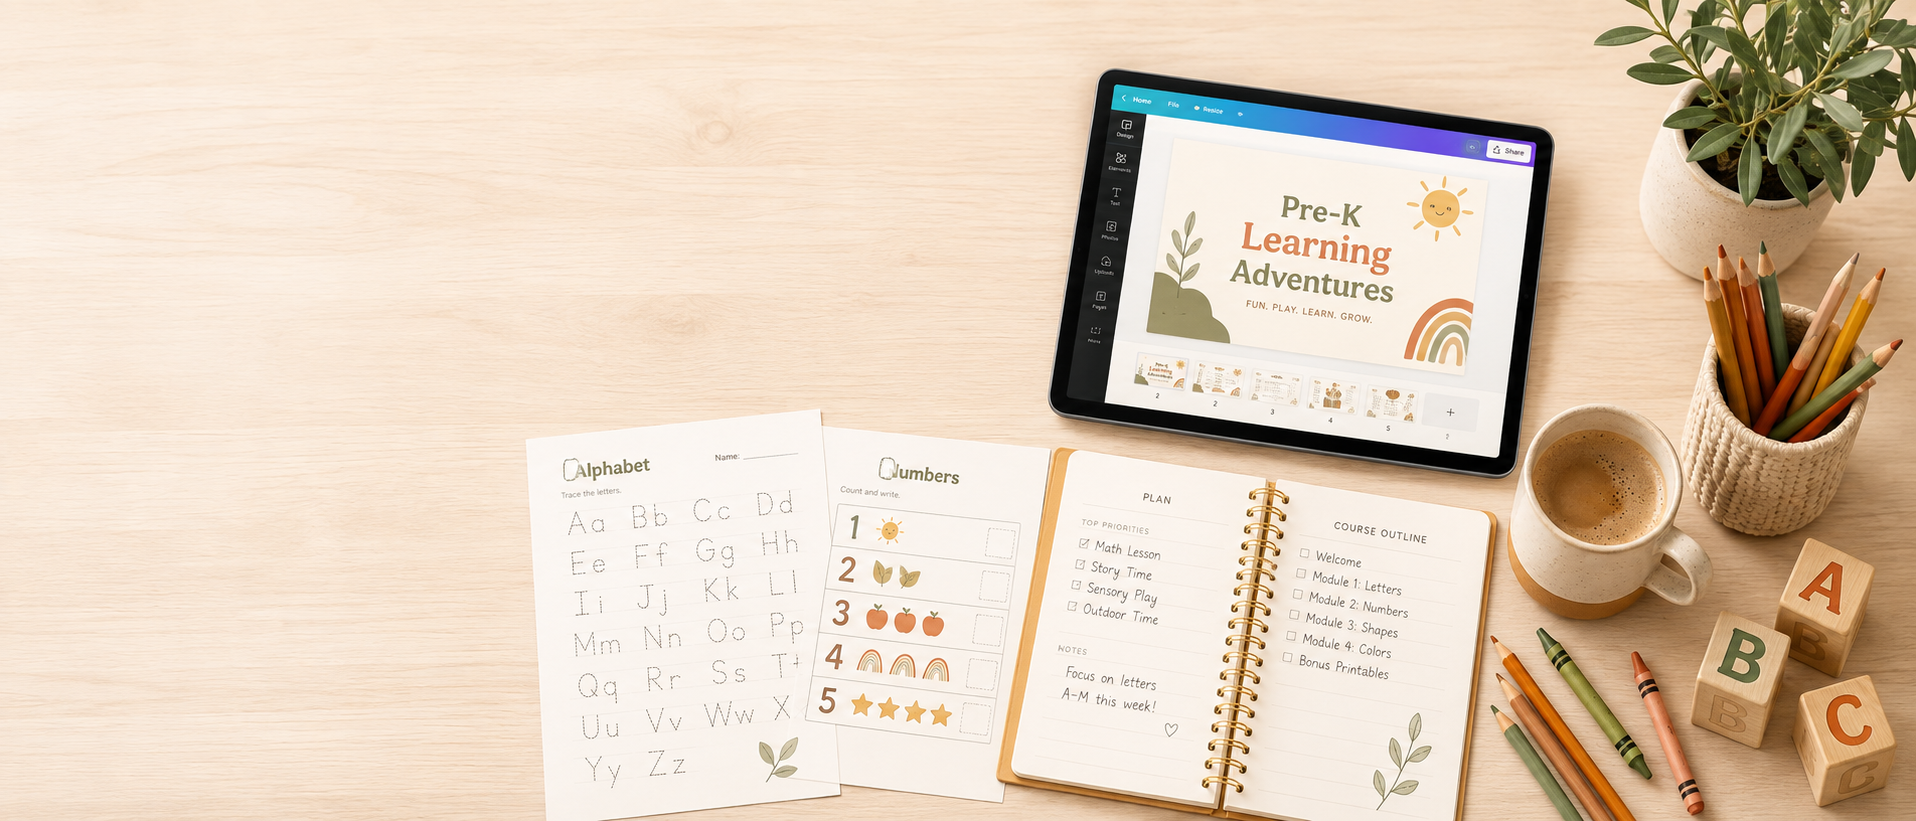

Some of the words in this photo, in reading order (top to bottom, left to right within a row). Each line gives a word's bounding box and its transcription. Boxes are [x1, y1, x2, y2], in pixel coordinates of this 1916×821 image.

[1132, 96, 1152, 105] Home
[1504, 148, 1524, 156] Share
[1281, 195, 1363, 228] Pre-K
[1241, 221, 1393, 276] Learning
[1229, 259, 1394, 303] Adventures
[1246, 299, 1268, 310] FUN.
[1272, 303, 1298, 314] PLAY.
[1302, 307, 1337, 320] LEARN.
[1340, 312, 1373, 324] GROW.
[1213, 400, 1218, 408] 2
[1270, 408, 1275, 416] 3
[714, 453, 740, 462] Name:
[561, 490, 582, 499] Trace
[583, 489, 595, 498] the
[596, 487, 622, 496] letters.
[840, 485, 863, 495] Count
[864, 488, 878, 497] and
[880, 490, 901, 499] write.
[1142, 492, 1172, 505] PLAN
[567, 511, 605, 536] Aa
[632, 503, 668, 529] Bb
[693, 498, 730, 522] Cc
[756, 490, 793, 516] Dd
[1081, 518, 1099, 527] TOP
[1102, 521, 1150, 535] PRIORITIES
[850, 514, 860, 540] 1
[1333, 521, 1377, 537] COURSE
[1380, 528, 1428, 544] OUTLINE
[571, 550, 606, 576] Ee
[635, 542, 668, 569] Ff
[696, 538, 735, 569] Gg
[761, 530, 798, 556] Hh
[1094, 540, 1122, 555] Math
[1127, 545, 1161, 561] Lesson
[1316, 550, 1362, 568] Welcome
[838, 556, 857, 583] 2
[1090, 560, 1120, 580] Story
[1126, 566, 1152, 581] Time
[637, 584, 668, 616] Jj
[704, 576, 739, 602] Kk
[1086, 581, 1128, 604] Sensory
[1134, 588, 1158, 609] Play
[1312, 570, 1350, 588] Module
[1353, 578, 1362, 590] 1:
[1364, 580, 1402, 597] Letters
[1798, 560, 1844, 616] A
[832, 599, 850, 626] 3
[1083, 602, 1127, 620] Outdoor
[1133, 610, 1159, 626] Time
[1308, 591, 1346, 608] Module
[1349, 599, 1360, 610] 2:
[1362, 600, 1409, 619] Numbers
[574, 631, 621, 657] Mm
[644, 624, 682, 650] Nn
[708, 618, 746, 643] Oo
[770, 612, 804, 644] Pp
[1305, 612, 1343, 629] Module
[1347, 619, 1357, 632] 3:
[1360, 622, 1399, 640] Shapes
[824, 643, 844, 670] 4
[1058, 644, 1088, 656] NOTES
[1302, 634, 1340, 650] Module
[1344, 640, 1355, 652] 4:
[1358, 643, 1392, 659] Colors
[1716, 627, 1767, 684] B
[1066, 665, 1096, 682] Focus
[1100, 674, 1114, 685] on
[1120, 674, 1157, 691] letters
[1299, 654, 1331, 671] Bonus
[1335, 660, 1390, 680] Printables
[578, 672, 618, 704] Qq
[647, 666, 681, 692] Rr
[712, 660, 746, 684] Ss
[818, 686, 837, 714] 5
[1096, 694, 1117, 708] this
[1123, 700, 1157, 714] week!
[1708, 694, 1748, 733] B
[582, 714, 619, 740] Uu
[646, 707, 682, 733] Vv
[704, 700, 754, 727] Ww
[1825, 693, 1873, 747] C
[585, 756, 621, 789] Yy
[648, 750, 686, 777] Zz
